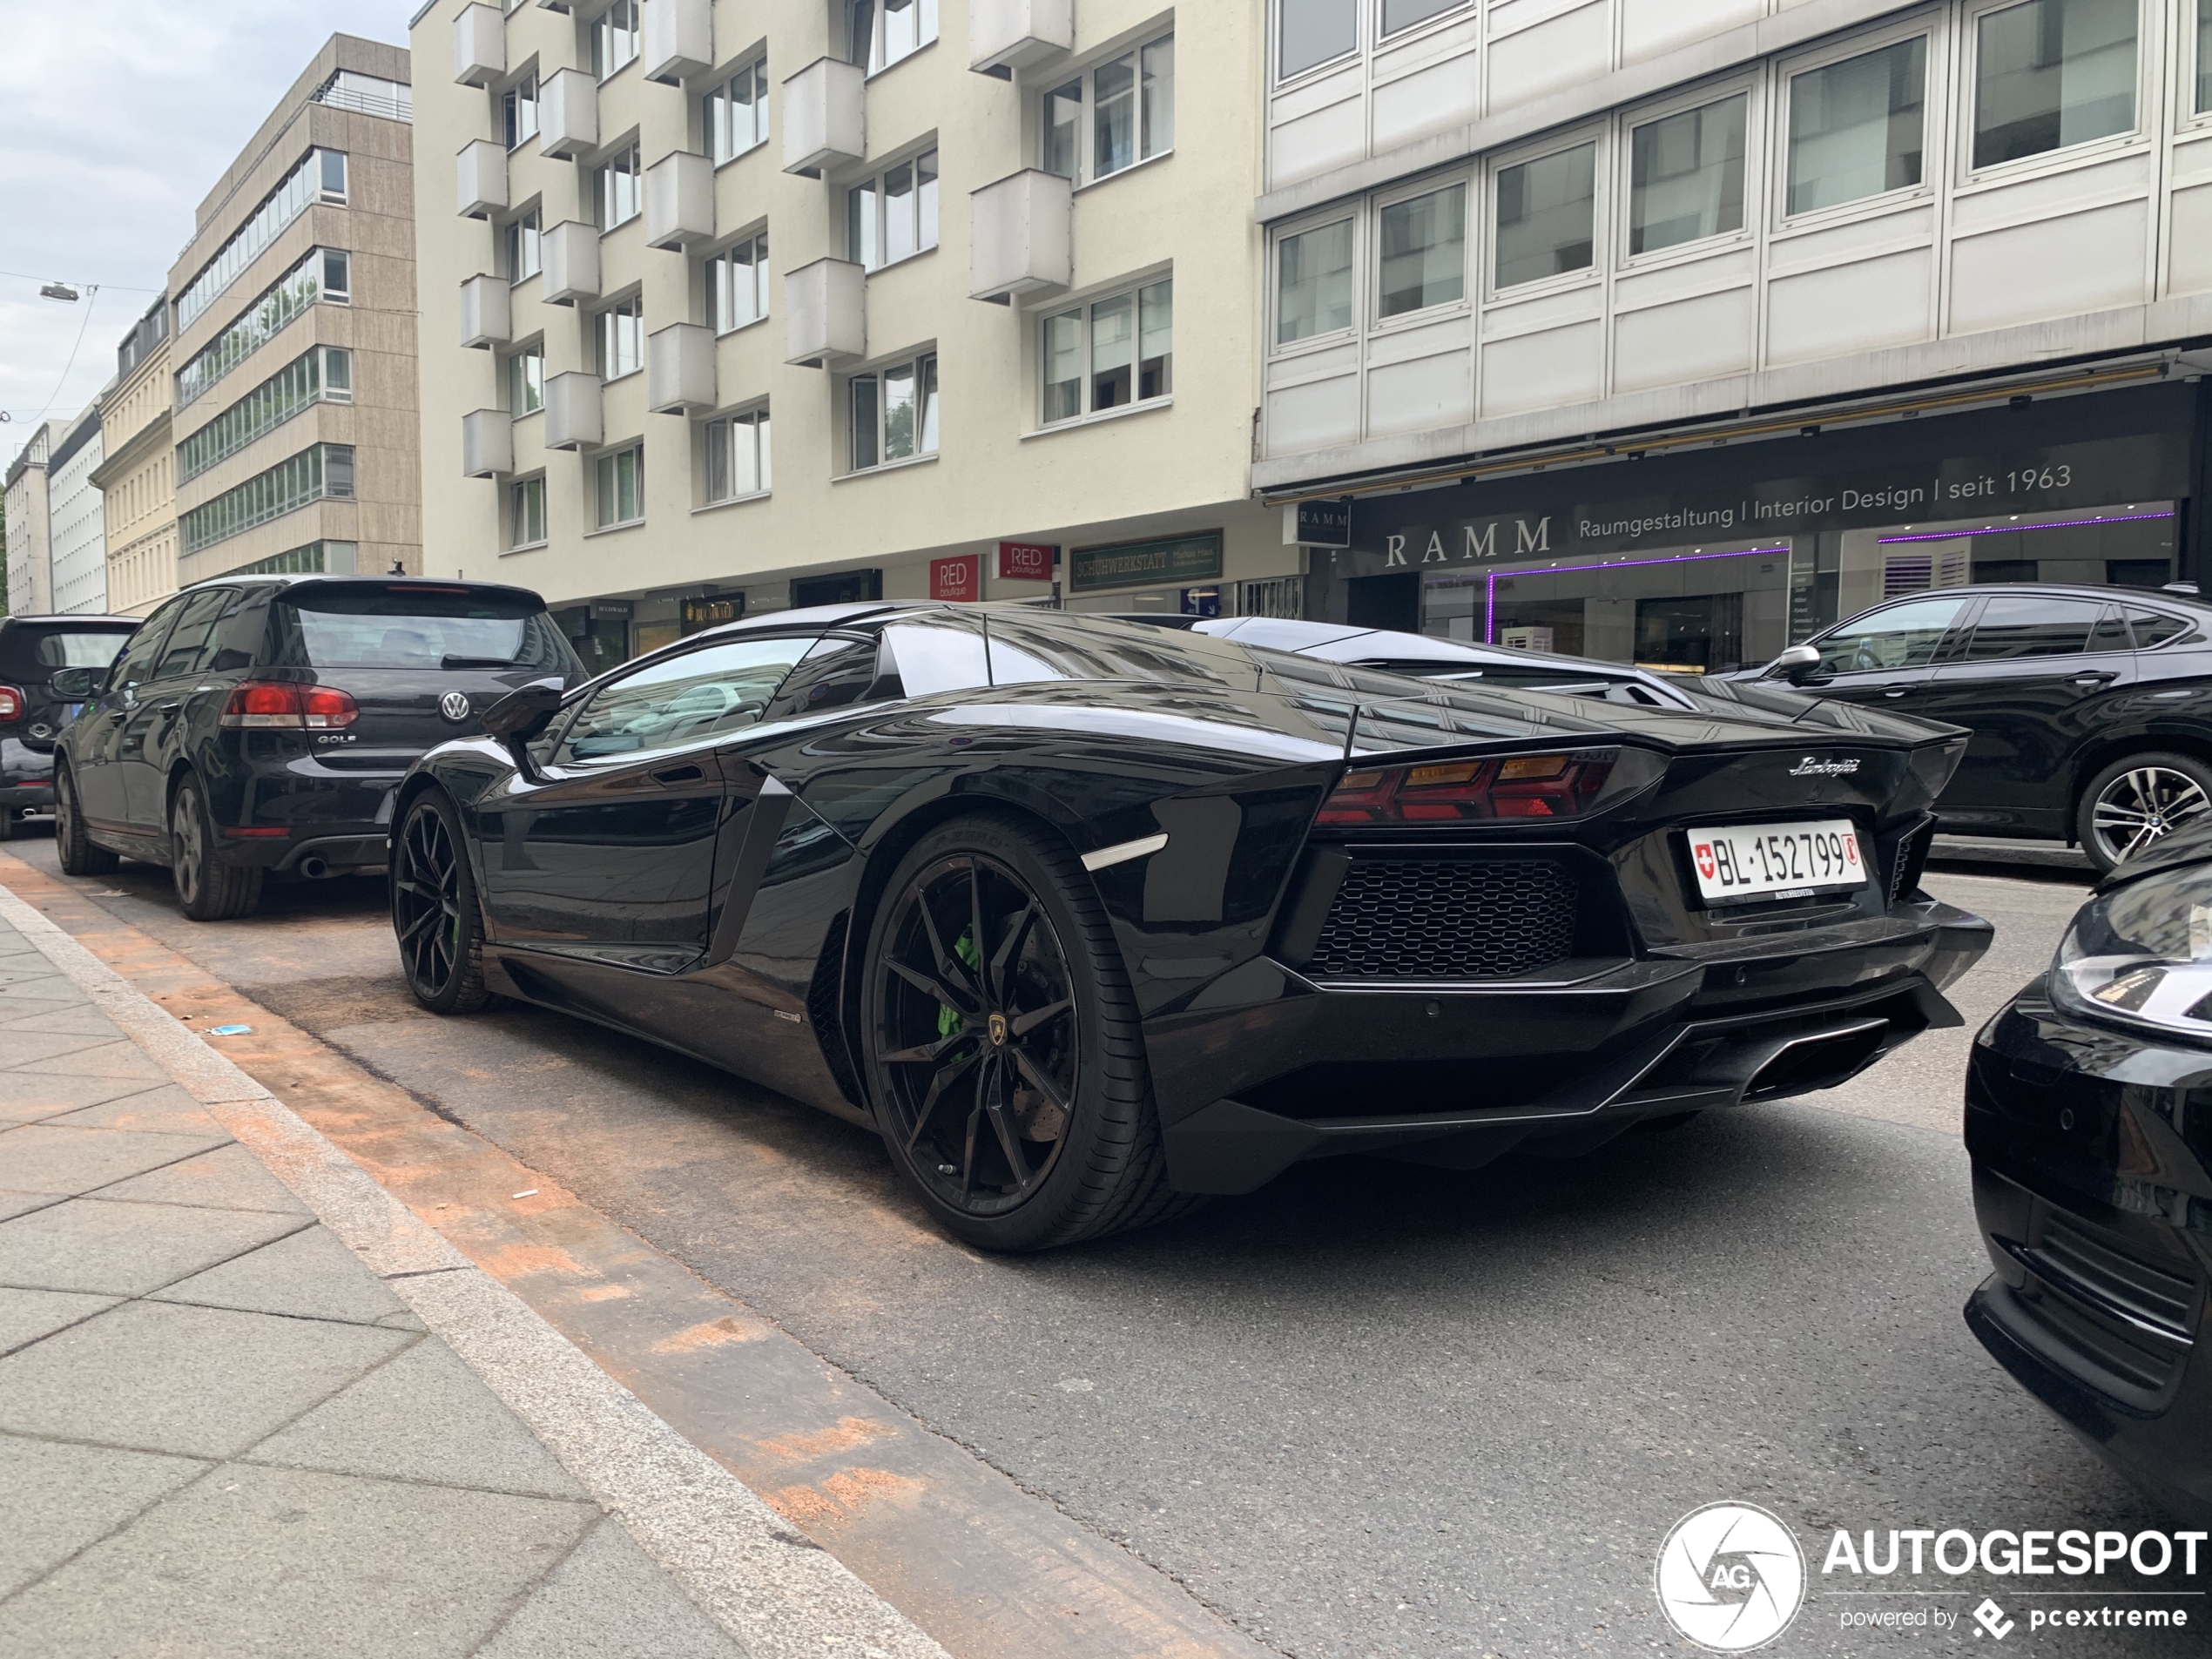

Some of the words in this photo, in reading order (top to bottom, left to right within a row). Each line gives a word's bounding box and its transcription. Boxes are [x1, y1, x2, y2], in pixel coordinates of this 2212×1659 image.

[1299, 510, 1348, 526] RAMM
[1385, 516, 1552, 567] RAMM
[1580, 508, 1734, 538] Raumgestaltung
[1755, 495, 1834, 520] Interior
[1842, 485, 1924, 511] Design
[1948, 475, 1995, 499] seit
[2006, 464, 2072, 493] 1963
[1011, 548, 1042, 566] RED
[1076, 551, 1167, 577] SCHUHWERKSTATT
[940, 563, 968, 587] RED
[1011, 565, 1042, 575] boutique
[940, 586, 967, 598] boutique
[318, 735, 357, 744] GOLF
[1788, 756, 1862, 777] Lamborghini
